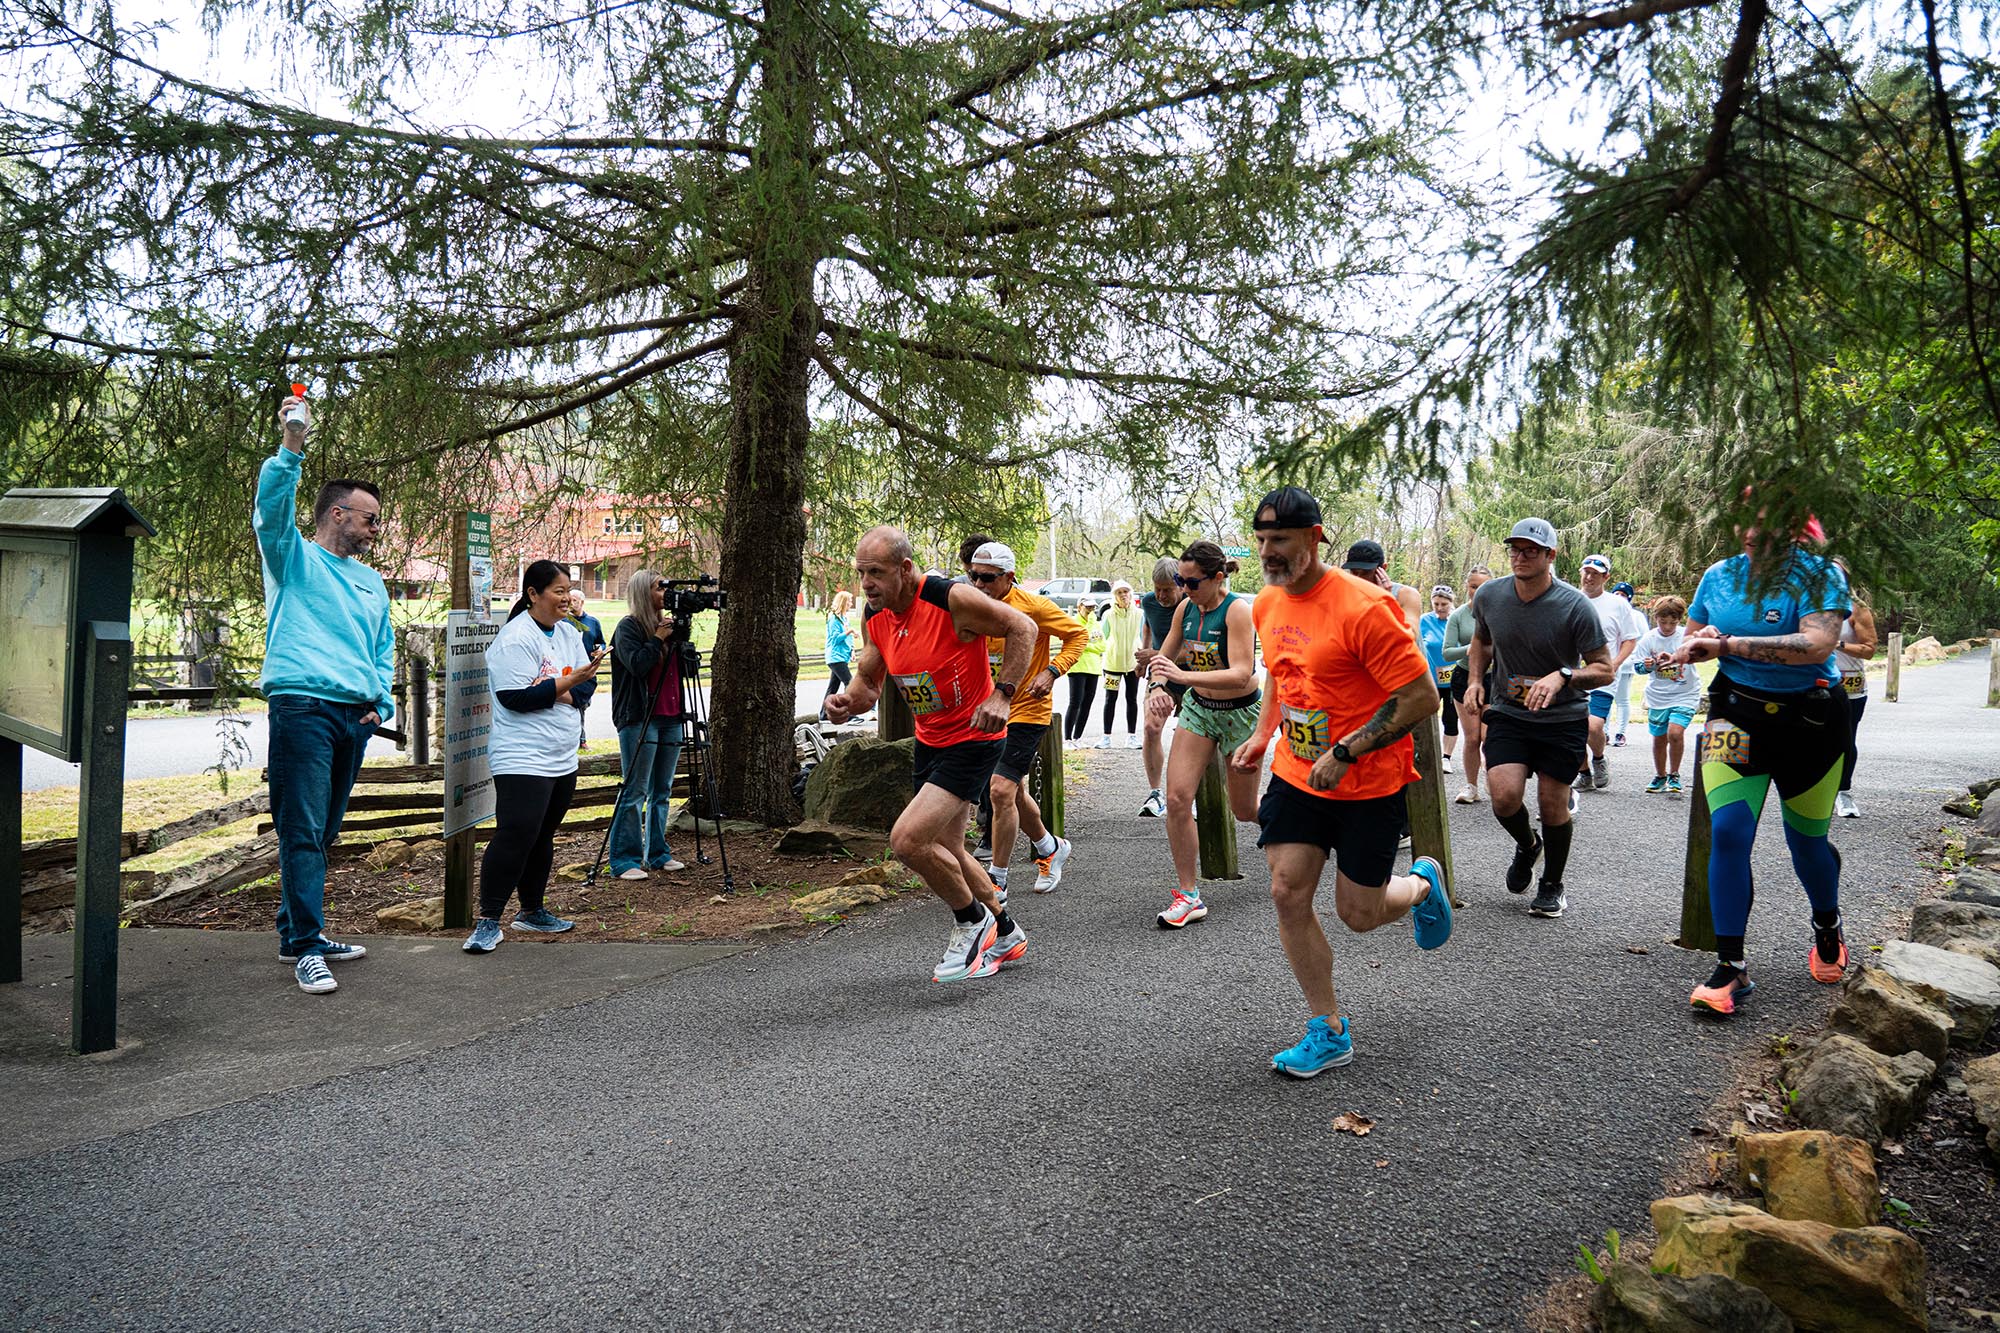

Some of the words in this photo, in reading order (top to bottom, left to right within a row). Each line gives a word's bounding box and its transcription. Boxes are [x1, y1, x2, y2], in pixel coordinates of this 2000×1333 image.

[471, 519, 488, 531] PLEASE
[468, 532, 480, 543] KEEP
[480, 534, 490, 544] DOG
[468, 545, 475, 554] ON
[475, 545, 490, 556] LEASH
[455, 623, 500, 638] AUTHORIZED
[450, 642, 484, 656] VEHICLES
[1189, 650, 1217, 667] 258
[451, 671, 461, 682] NO
[462, 667, 489, 681] MOTORI
[1105, 677, 1120, 687] 246
[1438, 670, 1453, 680] 26
[900, 685, 933, 704] 259
[461, 707, 471, 719] NO
[472, 703, 490, 716] ATV'S
[448, 732, 458, 744] NO
[459, 724, 490, 741] ELECTRIC
[1284, 718, 1321, 746] 251
[1704, 731, 1740, 751] 250
[453, 749, 477, 764] MOTOR
[478, 745, 488, 756] BIK
